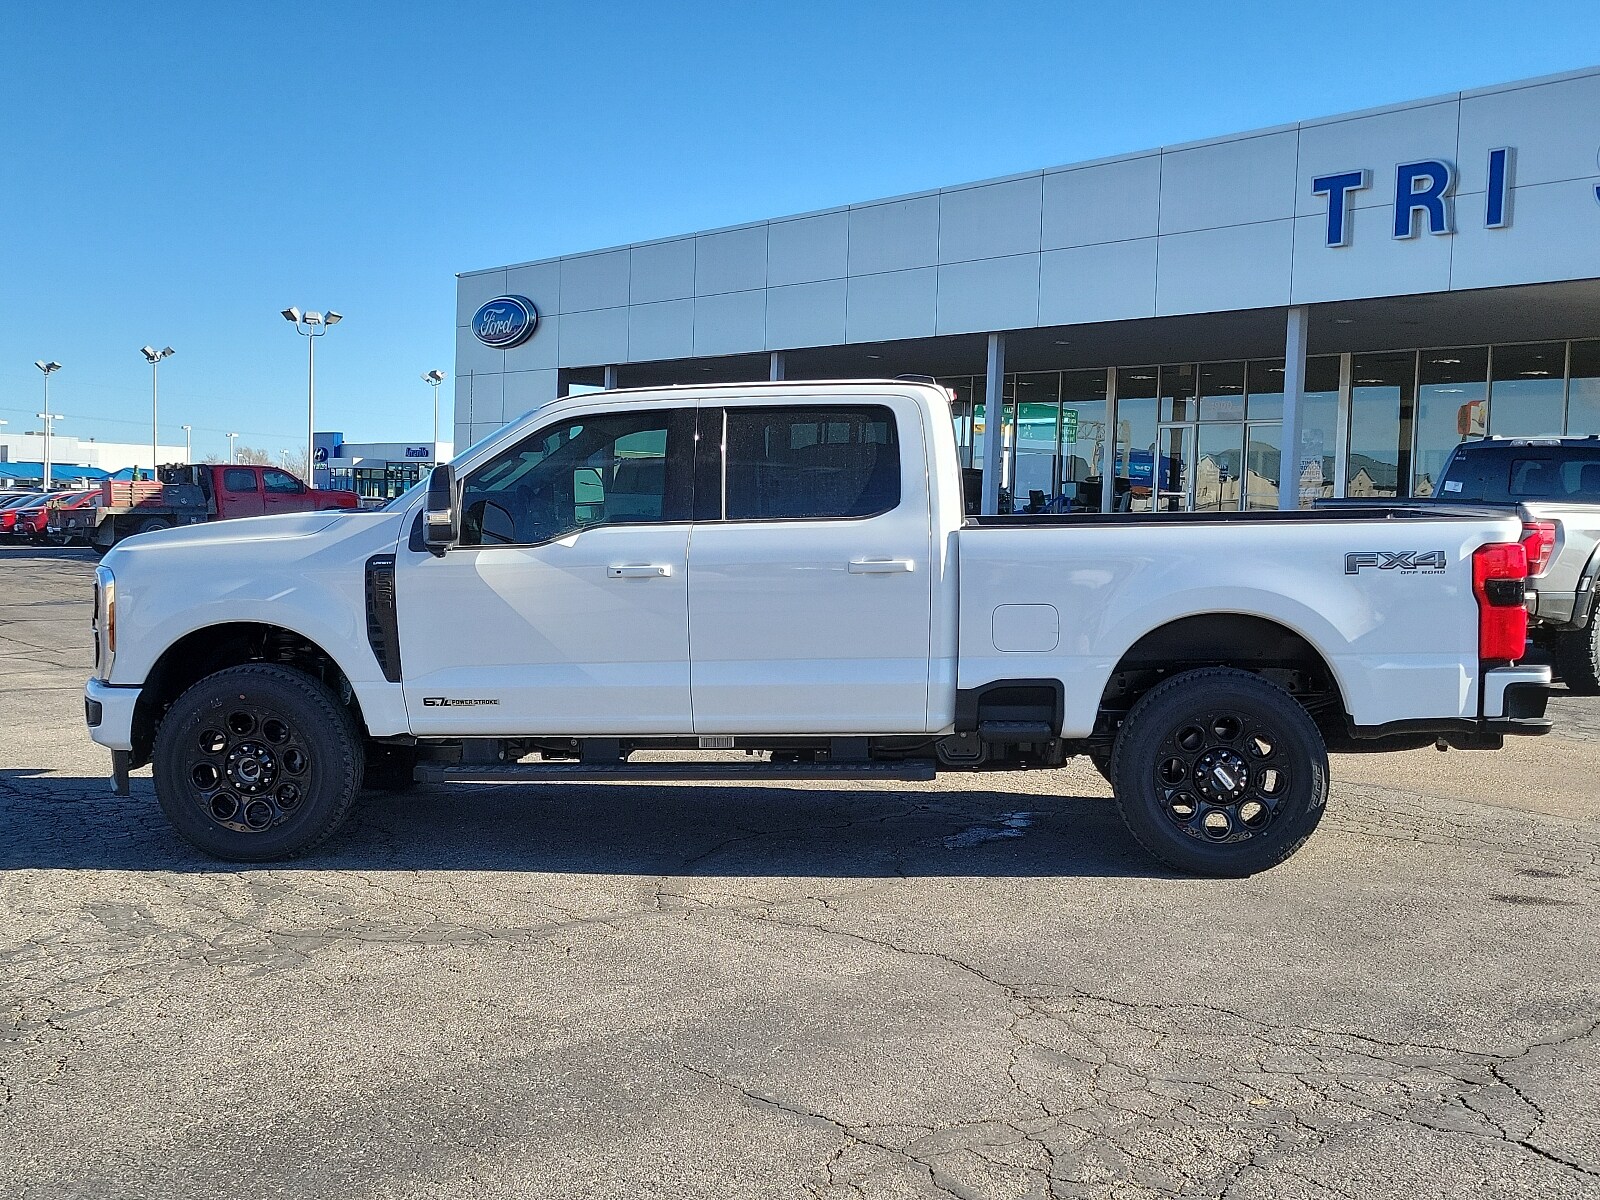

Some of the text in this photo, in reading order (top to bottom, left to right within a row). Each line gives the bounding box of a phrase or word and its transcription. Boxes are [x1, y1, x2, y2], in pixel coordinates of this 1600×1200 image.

[1311, 145, 1516, 248] TRI
[480, 308, 514, 336] Ford
[1344, 550, 1447, 575] FX4
